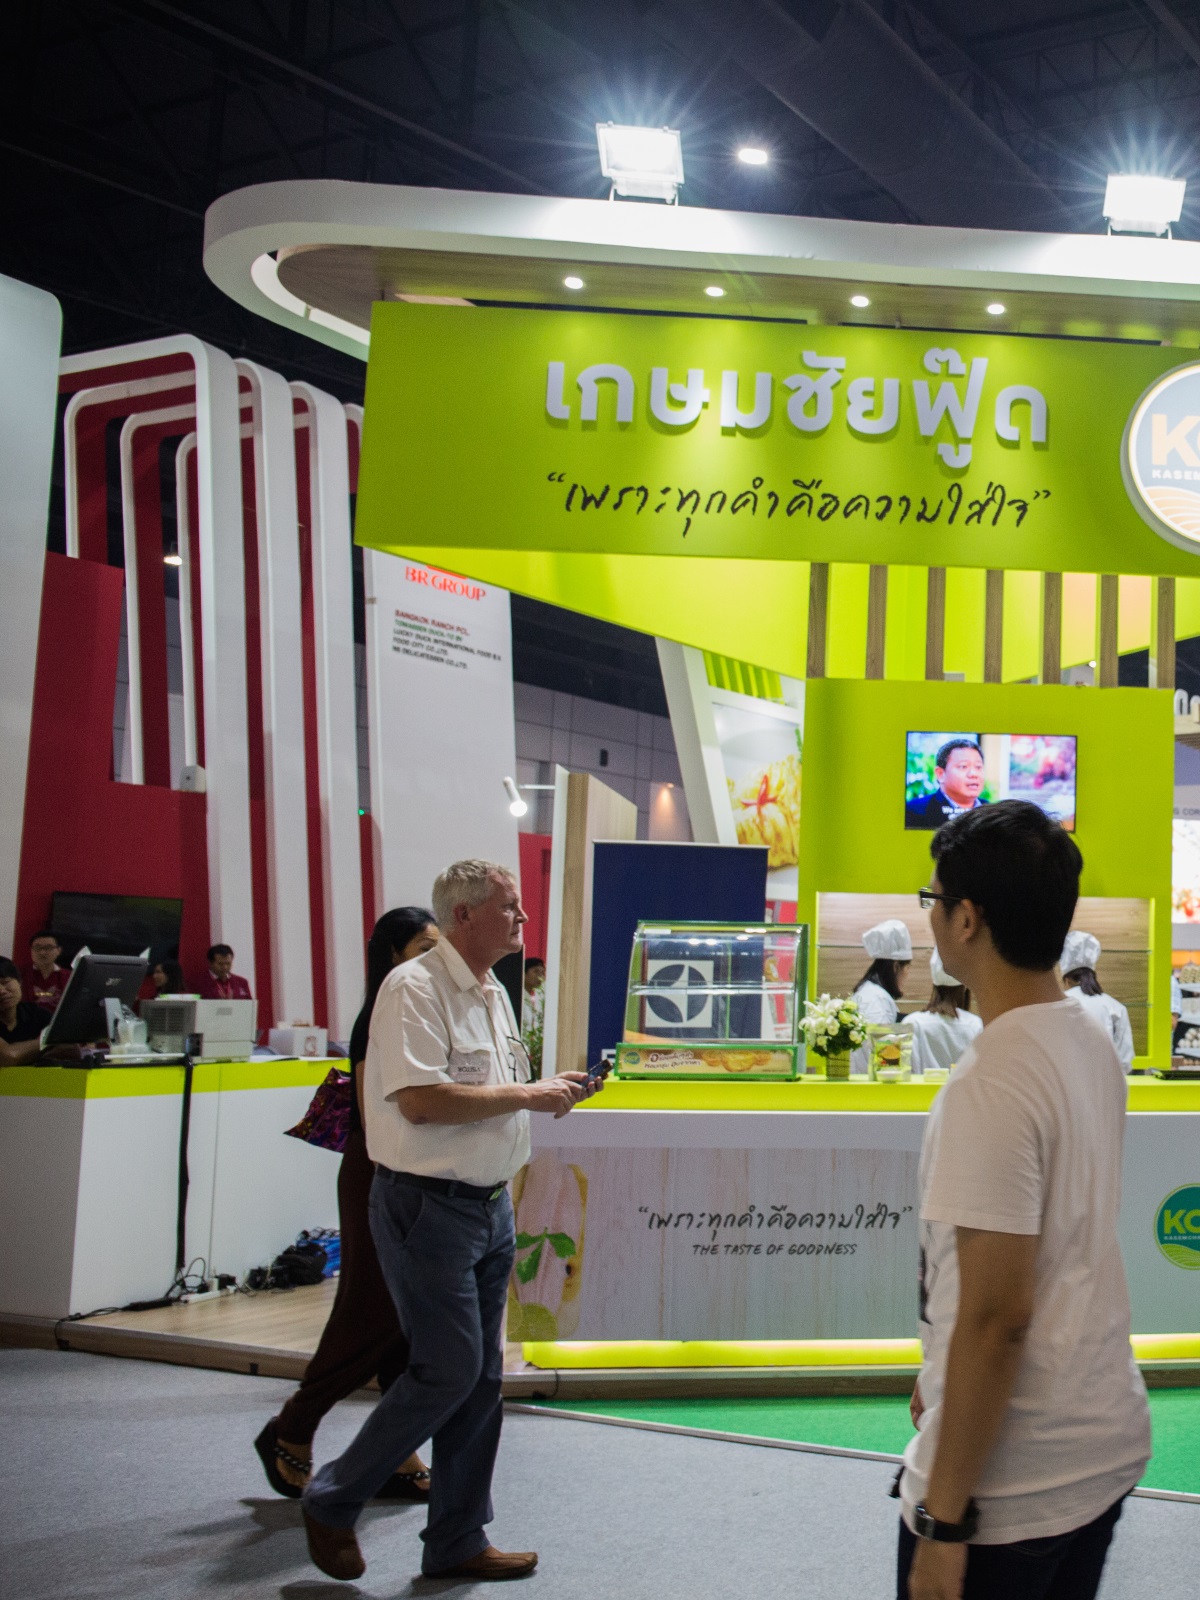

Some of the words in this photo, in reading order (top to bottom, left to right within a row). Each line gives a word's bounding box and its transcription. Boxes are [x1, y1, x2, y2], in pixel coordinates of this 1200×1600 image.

[545, 347, 1048, 470] เกษมชัยฟู๊ด
[405, 566, 429, 586] BR
[431, 574, 486, 601] GROUP
[692, 1243, 720, 1255] THE
[723, 1243, 763, 1255] TASTE
[766, 1243, 784, 1255] OF
[787, 1243, 858, 1255] GOODNESS
